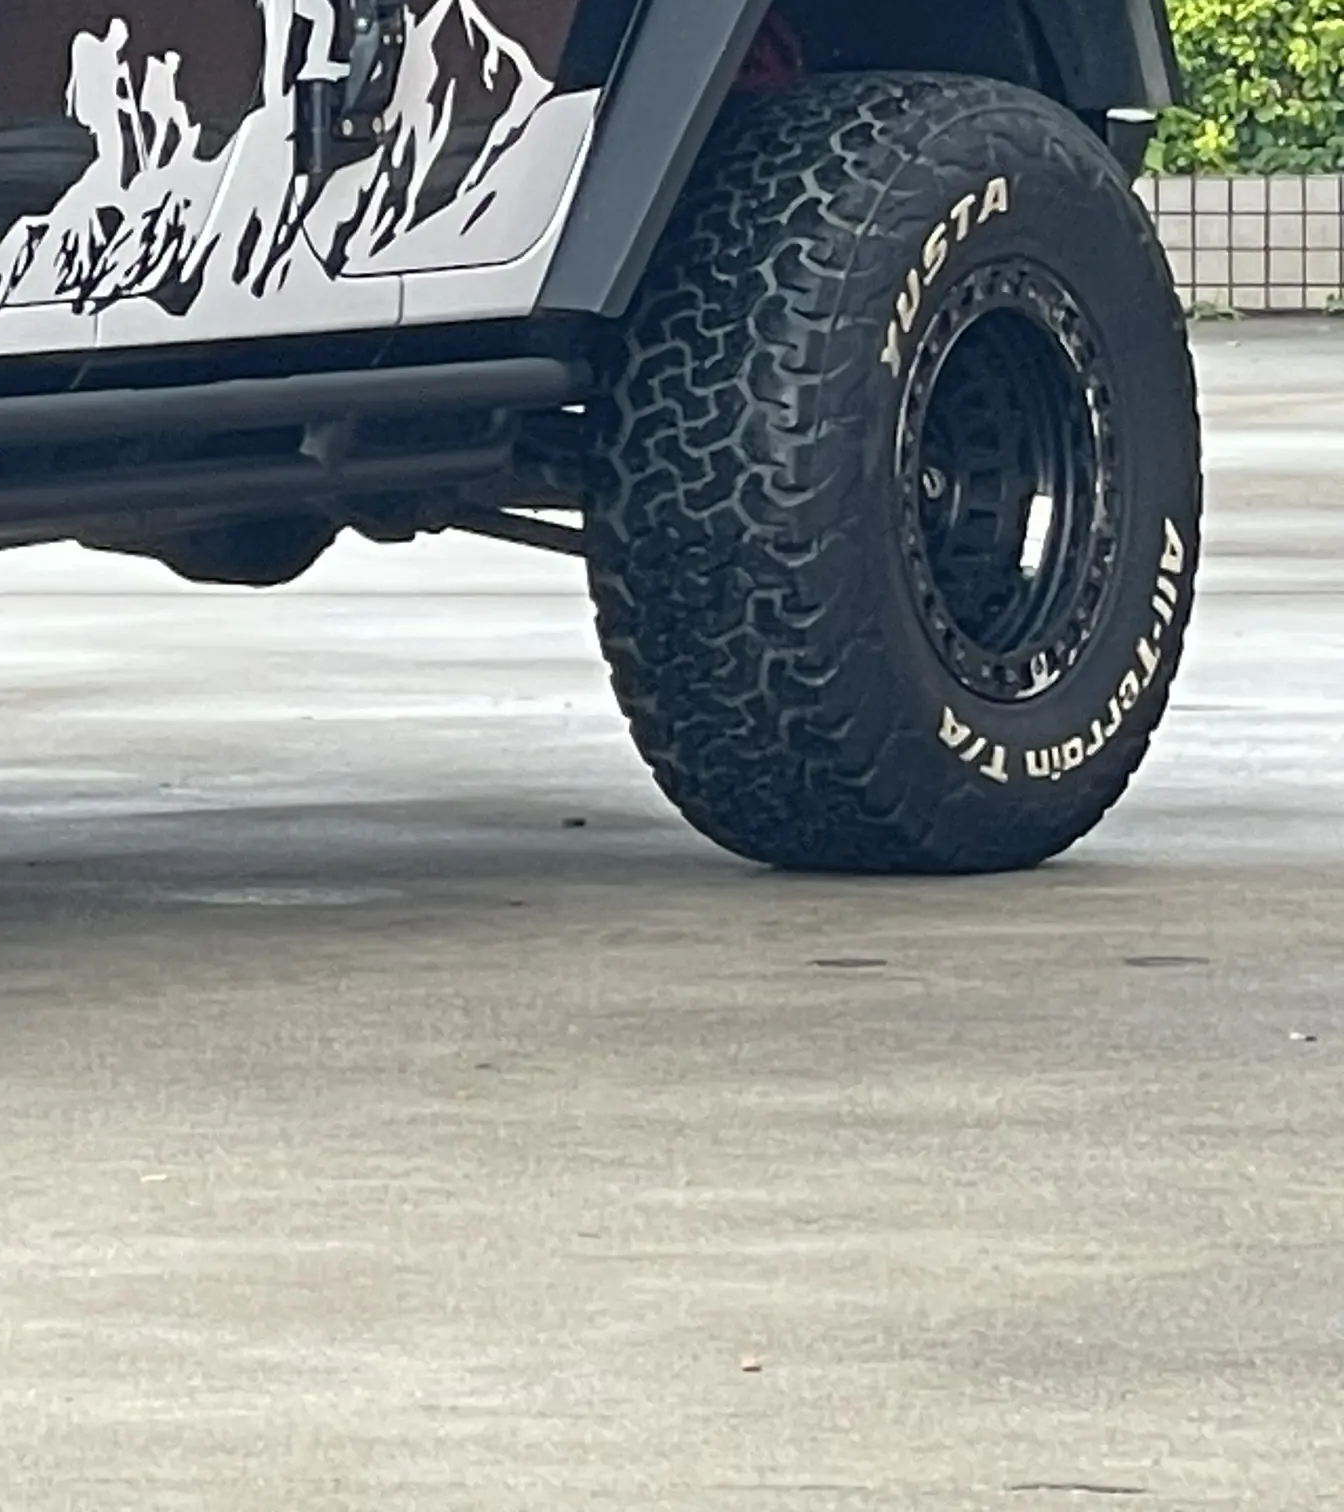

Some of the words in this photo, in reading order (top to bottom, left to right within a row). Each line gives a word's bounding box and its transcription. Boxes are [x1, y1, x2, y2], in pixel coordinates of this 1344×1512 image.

[880, 176, 1009, 378] YUSTA
[938, 705, 1009, 784] T/A
[1025, 517, 1185, 781] All-Terrain
